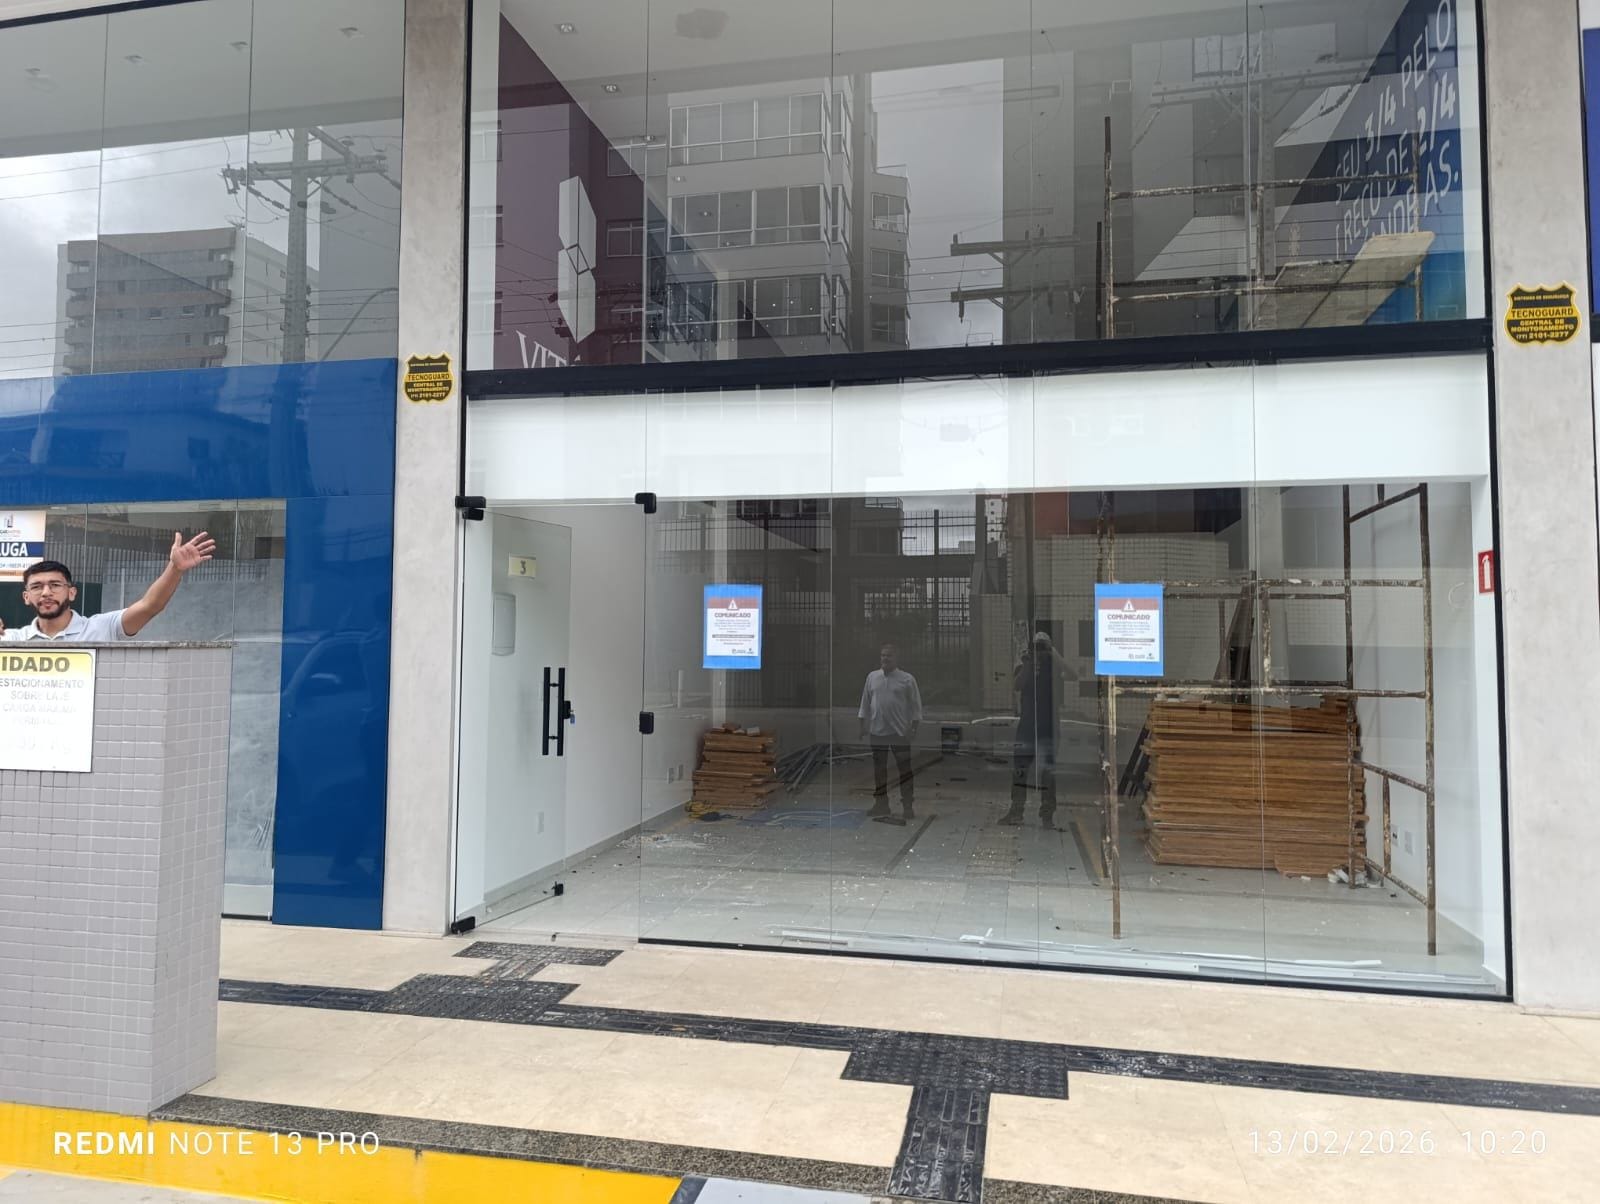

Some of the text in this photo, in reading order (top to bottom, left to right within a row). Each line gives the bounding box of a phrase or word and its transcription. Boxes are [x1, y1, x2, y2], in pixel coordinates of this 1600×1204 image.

[1365, 85, 1396, 161] 3/4
[1402, 0, 1451, 108] PELO
[1386, 128, 1409, 198] DE
[1416, 72, 1456, 156] 2/4
[1511, 307, 1574, 318] TECNOGUARD
[1511, 324, 1574, 333] MONITORAMENTO
[408, 373, 450, 381] TECNOGUARD
[0, 542, 29, 557] UGA
[520, 559, 527, 575] 3
[1107, 613, 1151, 621] COMUNICADO
[1, 656, 71, 673] IDADO
